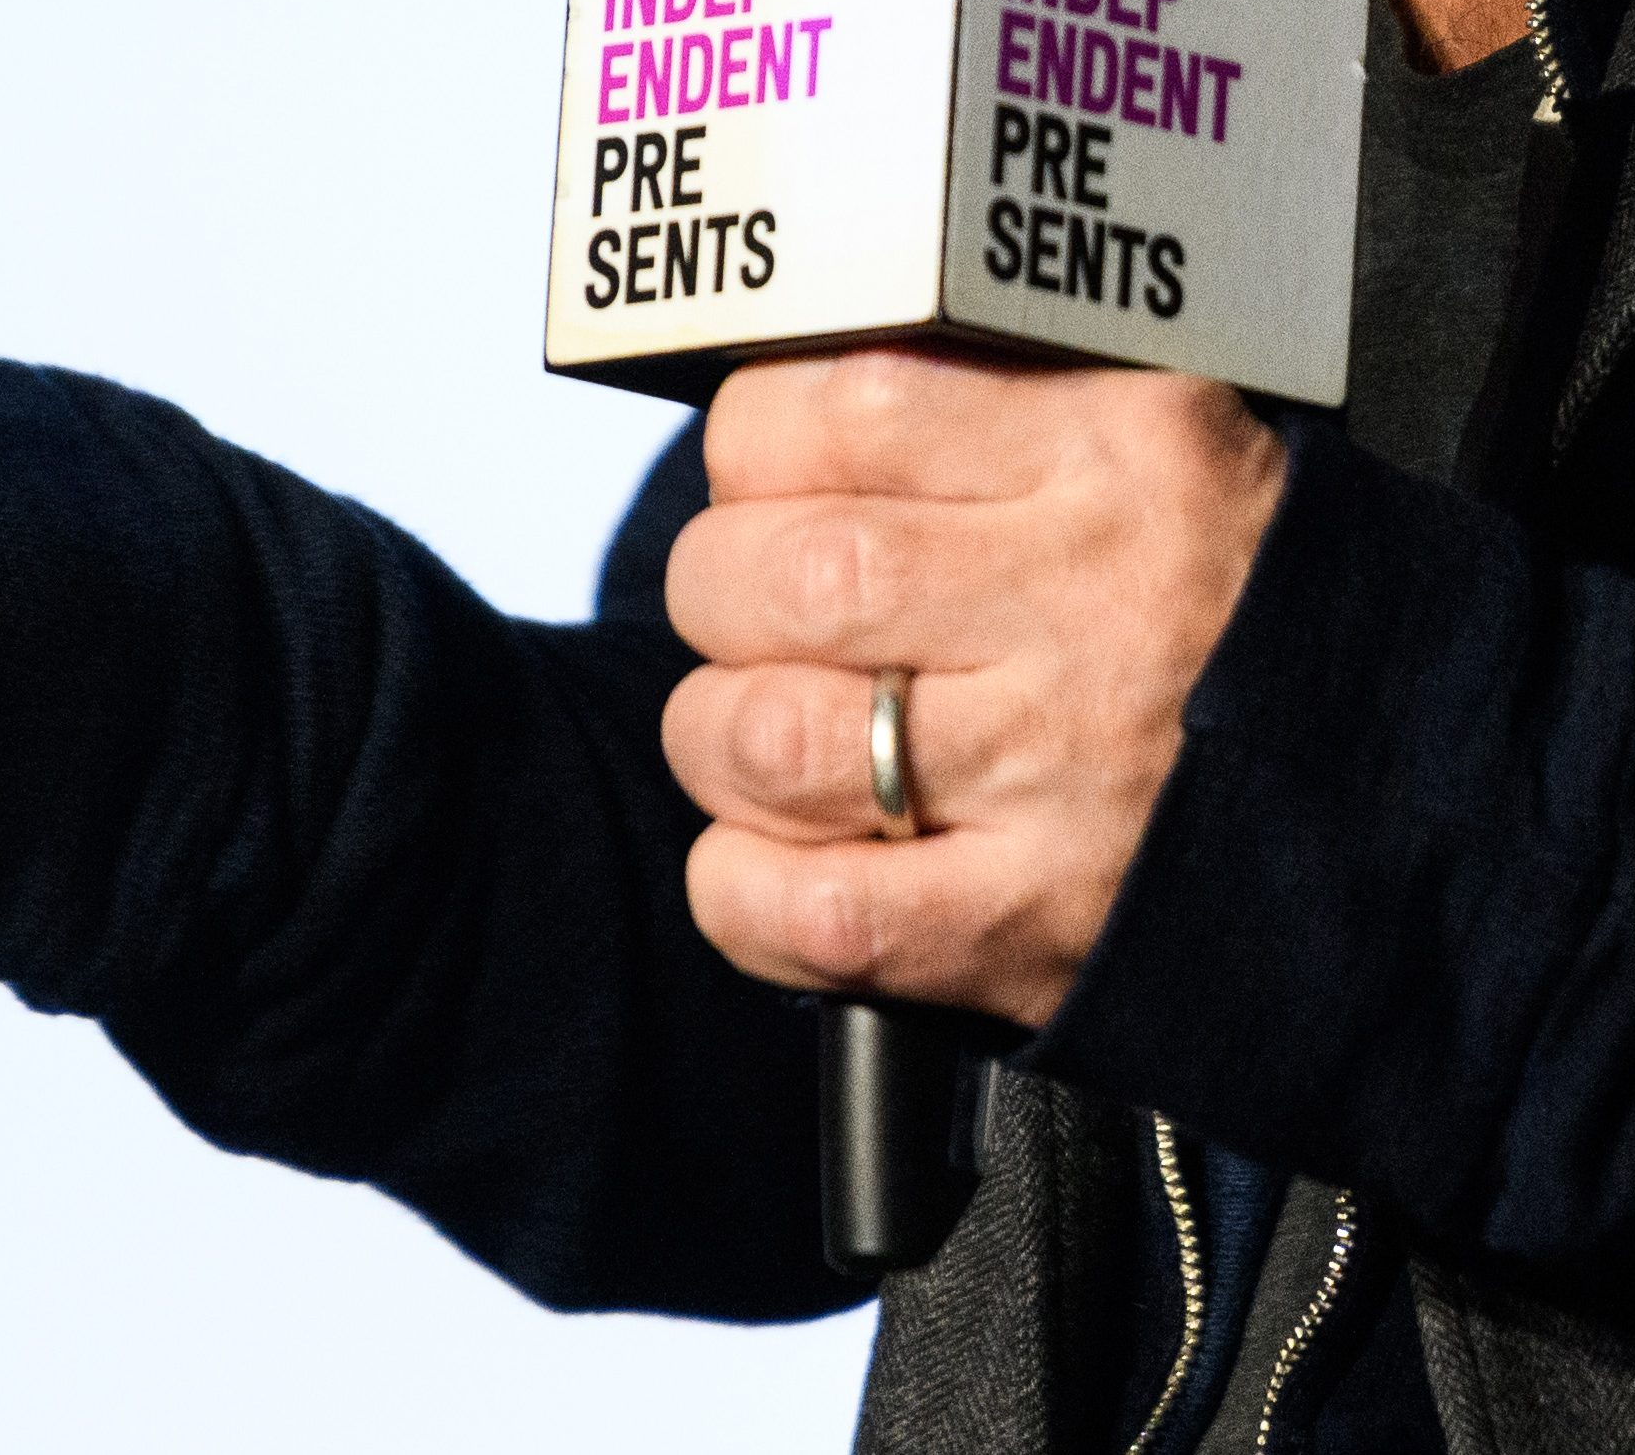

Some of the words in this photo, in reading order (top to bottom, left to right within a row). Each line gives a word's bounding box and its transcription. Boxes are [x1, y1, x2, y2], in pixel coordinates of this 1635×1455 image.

[597, 17, 833, 126] ENDENT
[995, 9, 1243, 145] ENDENT
[591, 124, 708, 219] PRE
[989, 101, 1114, 212] PRE
[584, 208, 777, 311] SENTS
[982, 194, 1188, 321] SENTS
